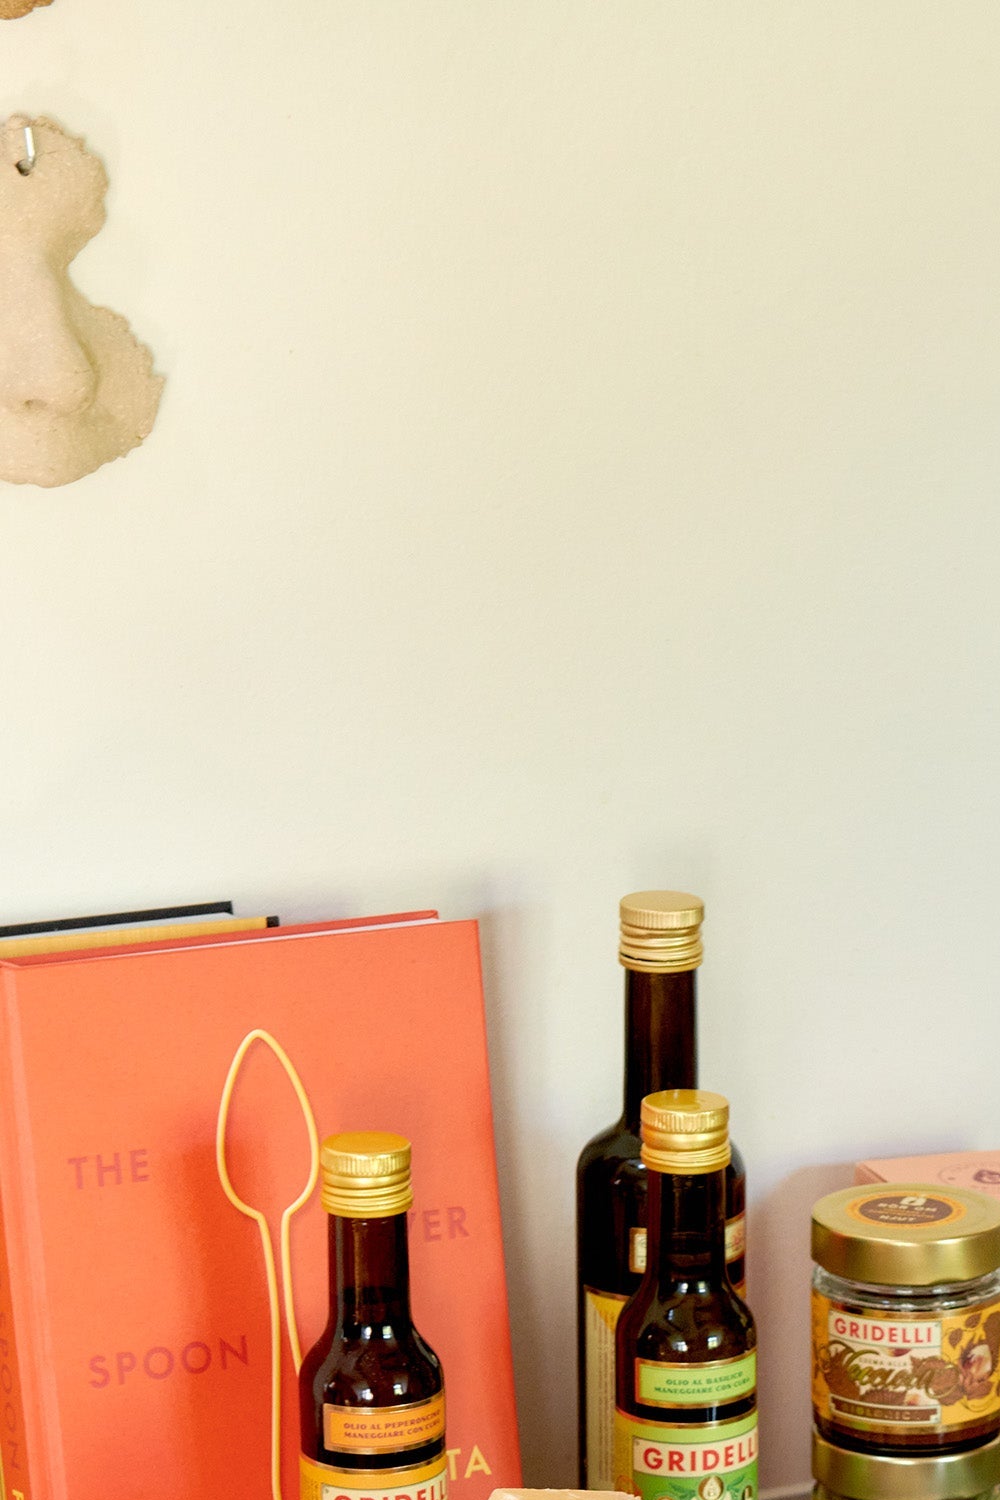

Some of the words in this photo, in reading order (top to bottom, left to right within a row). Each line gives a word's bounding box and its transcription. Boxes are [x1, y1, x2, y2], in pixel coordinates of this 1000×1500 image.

[68, 1149, 150, 1190] THE
[834, 1317, 932, 1344] GRIDELLI
[88, 1334, 249, 1389] SPOON
[343, 1422, 367, 1430] OLIO
[344, 1430, 404, 1439] MANEGGIARE
[407, 1426, 423, 1435] CON
[446, 1444, 492, 1481] TA
